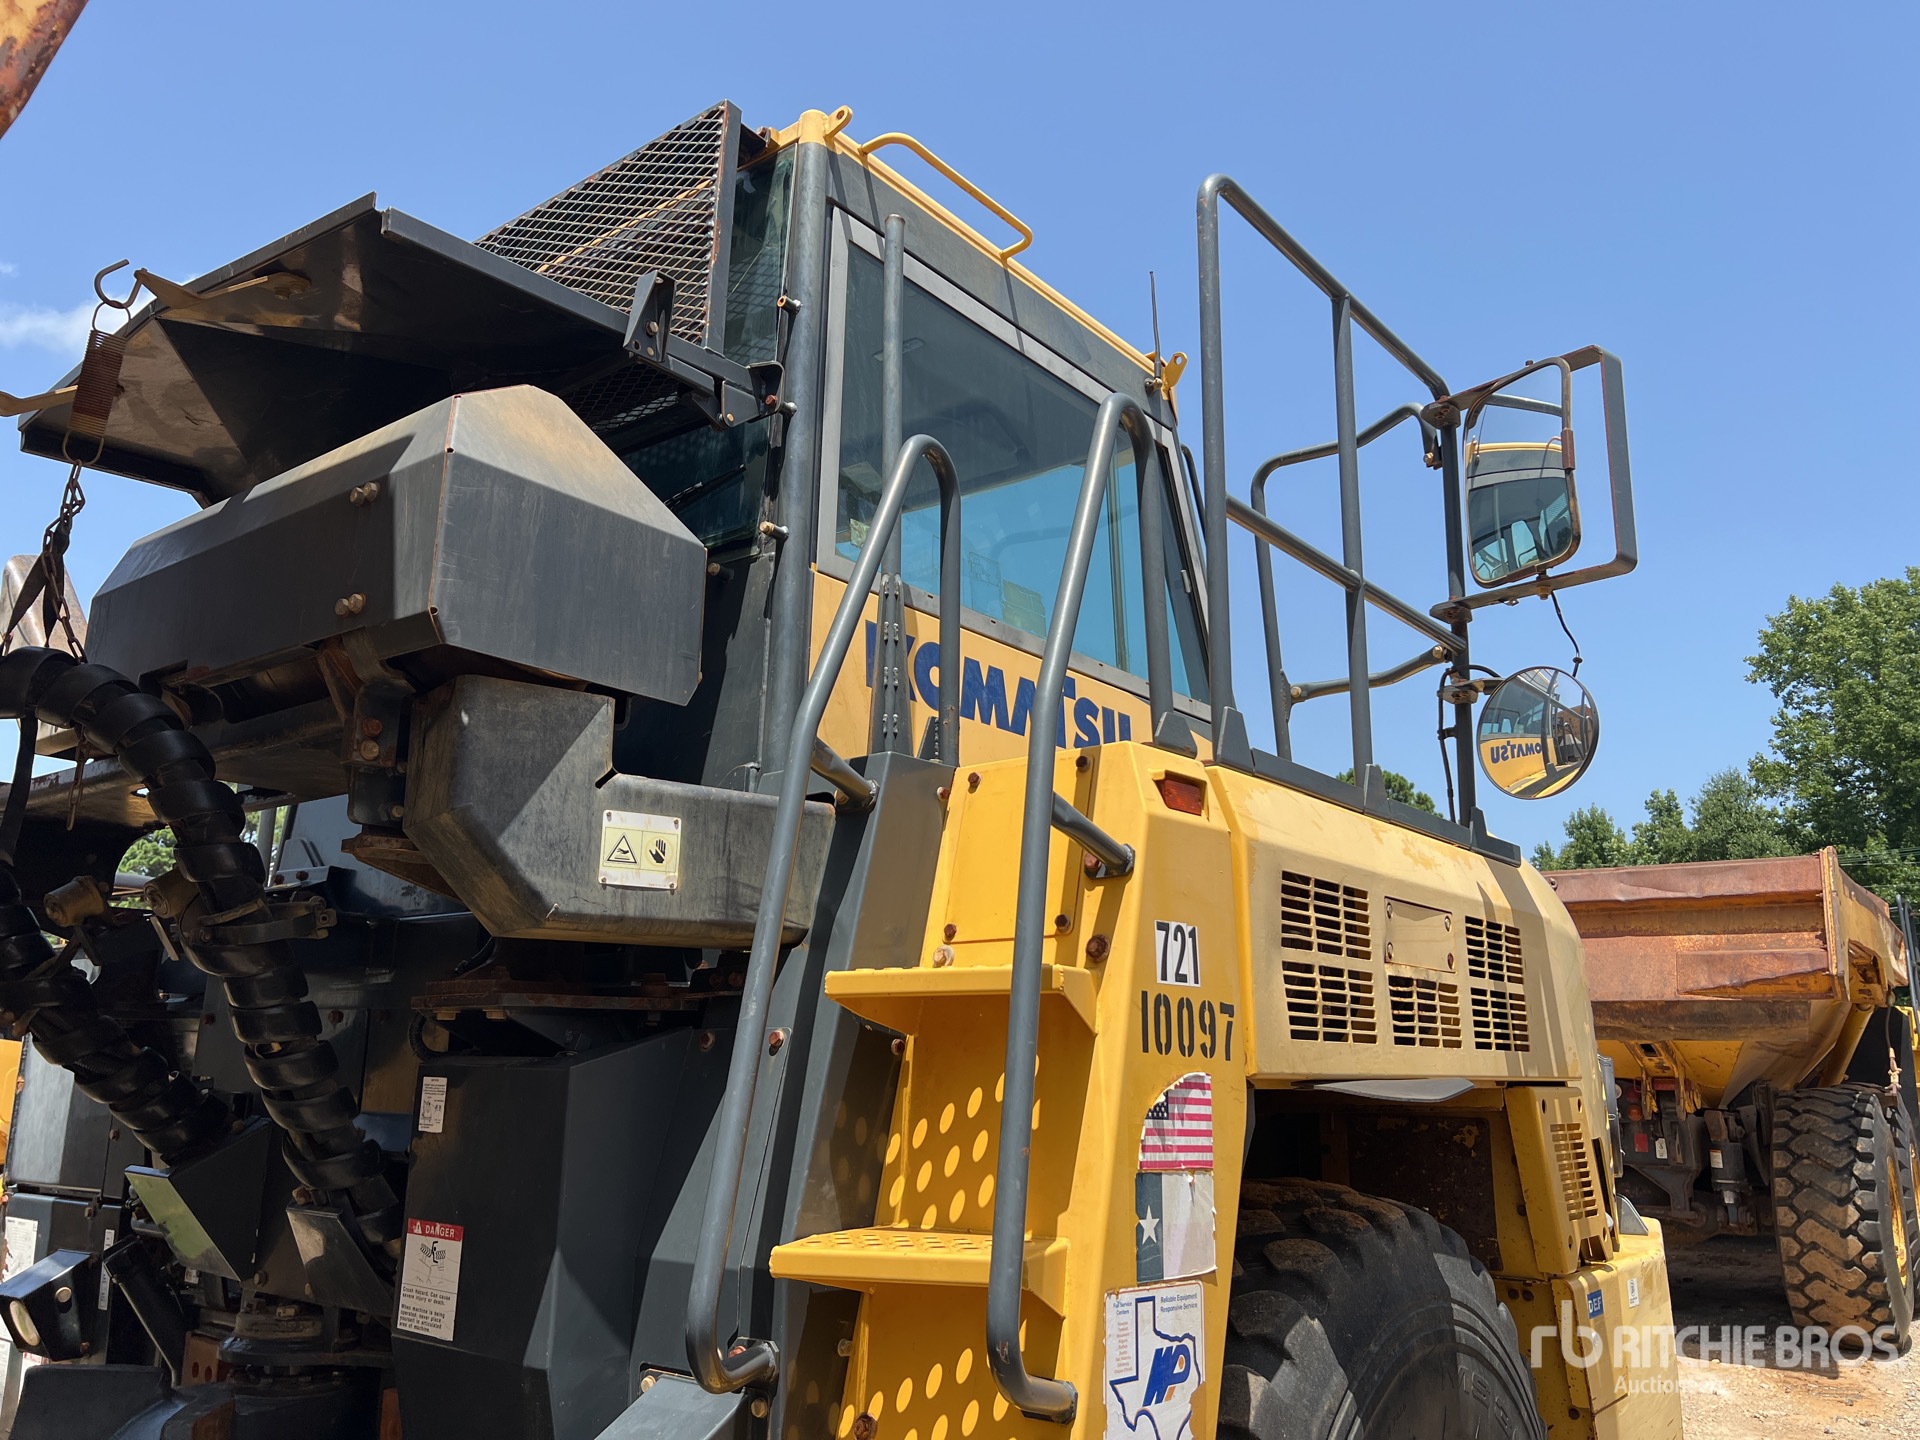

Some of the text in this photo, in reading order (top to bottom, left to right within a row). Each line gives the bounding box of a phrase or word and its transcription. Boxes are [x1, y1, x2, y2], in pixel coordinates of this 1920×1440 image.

[1156, 921, 1199, 985] 721
[1141, 990, 1235, 1061] 10097
[425, 1224, 455, 1238] DANGER
[1177, 1293, 1198, 1302] Equipment
[1588, 1297, 1602, 1313] DEF
